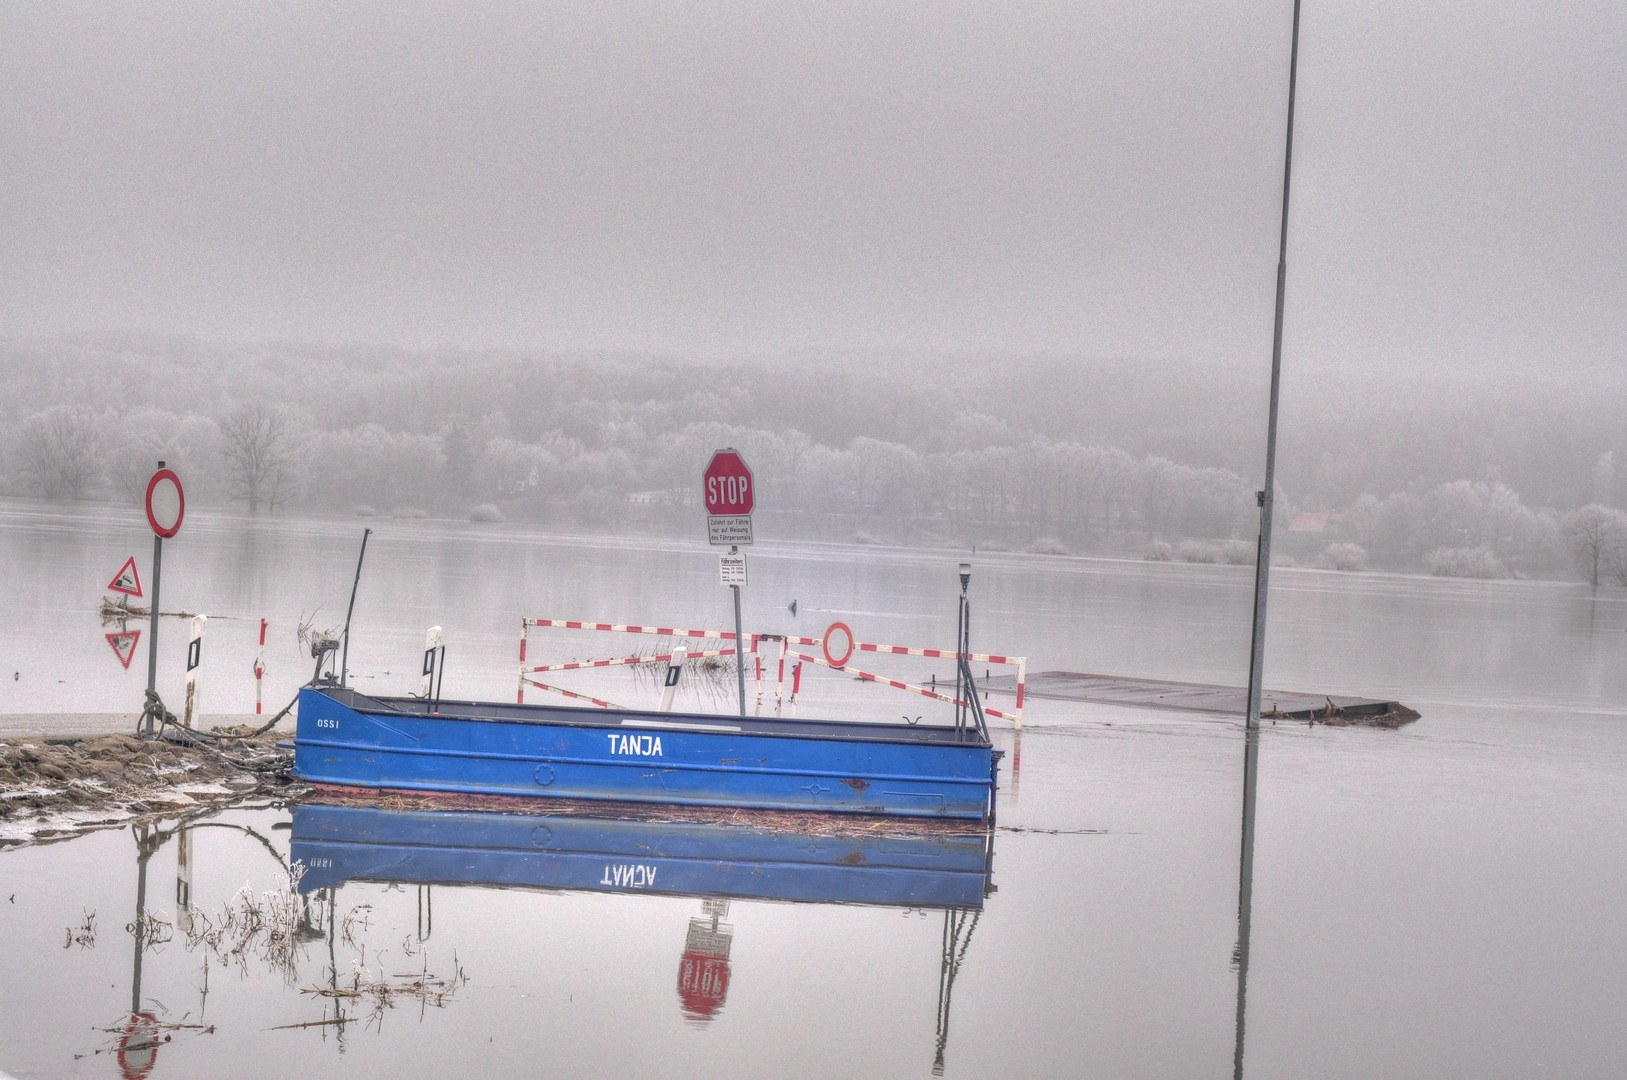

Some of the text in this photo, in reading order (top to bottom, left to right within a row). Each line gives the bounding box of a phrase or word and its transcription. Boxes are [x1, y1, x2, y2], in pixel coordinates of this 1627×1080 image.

[708, 475, 748, 505] STOP
[317, 718, 339, 729] OSSI
[607, 734, 663, 757] TANJA
